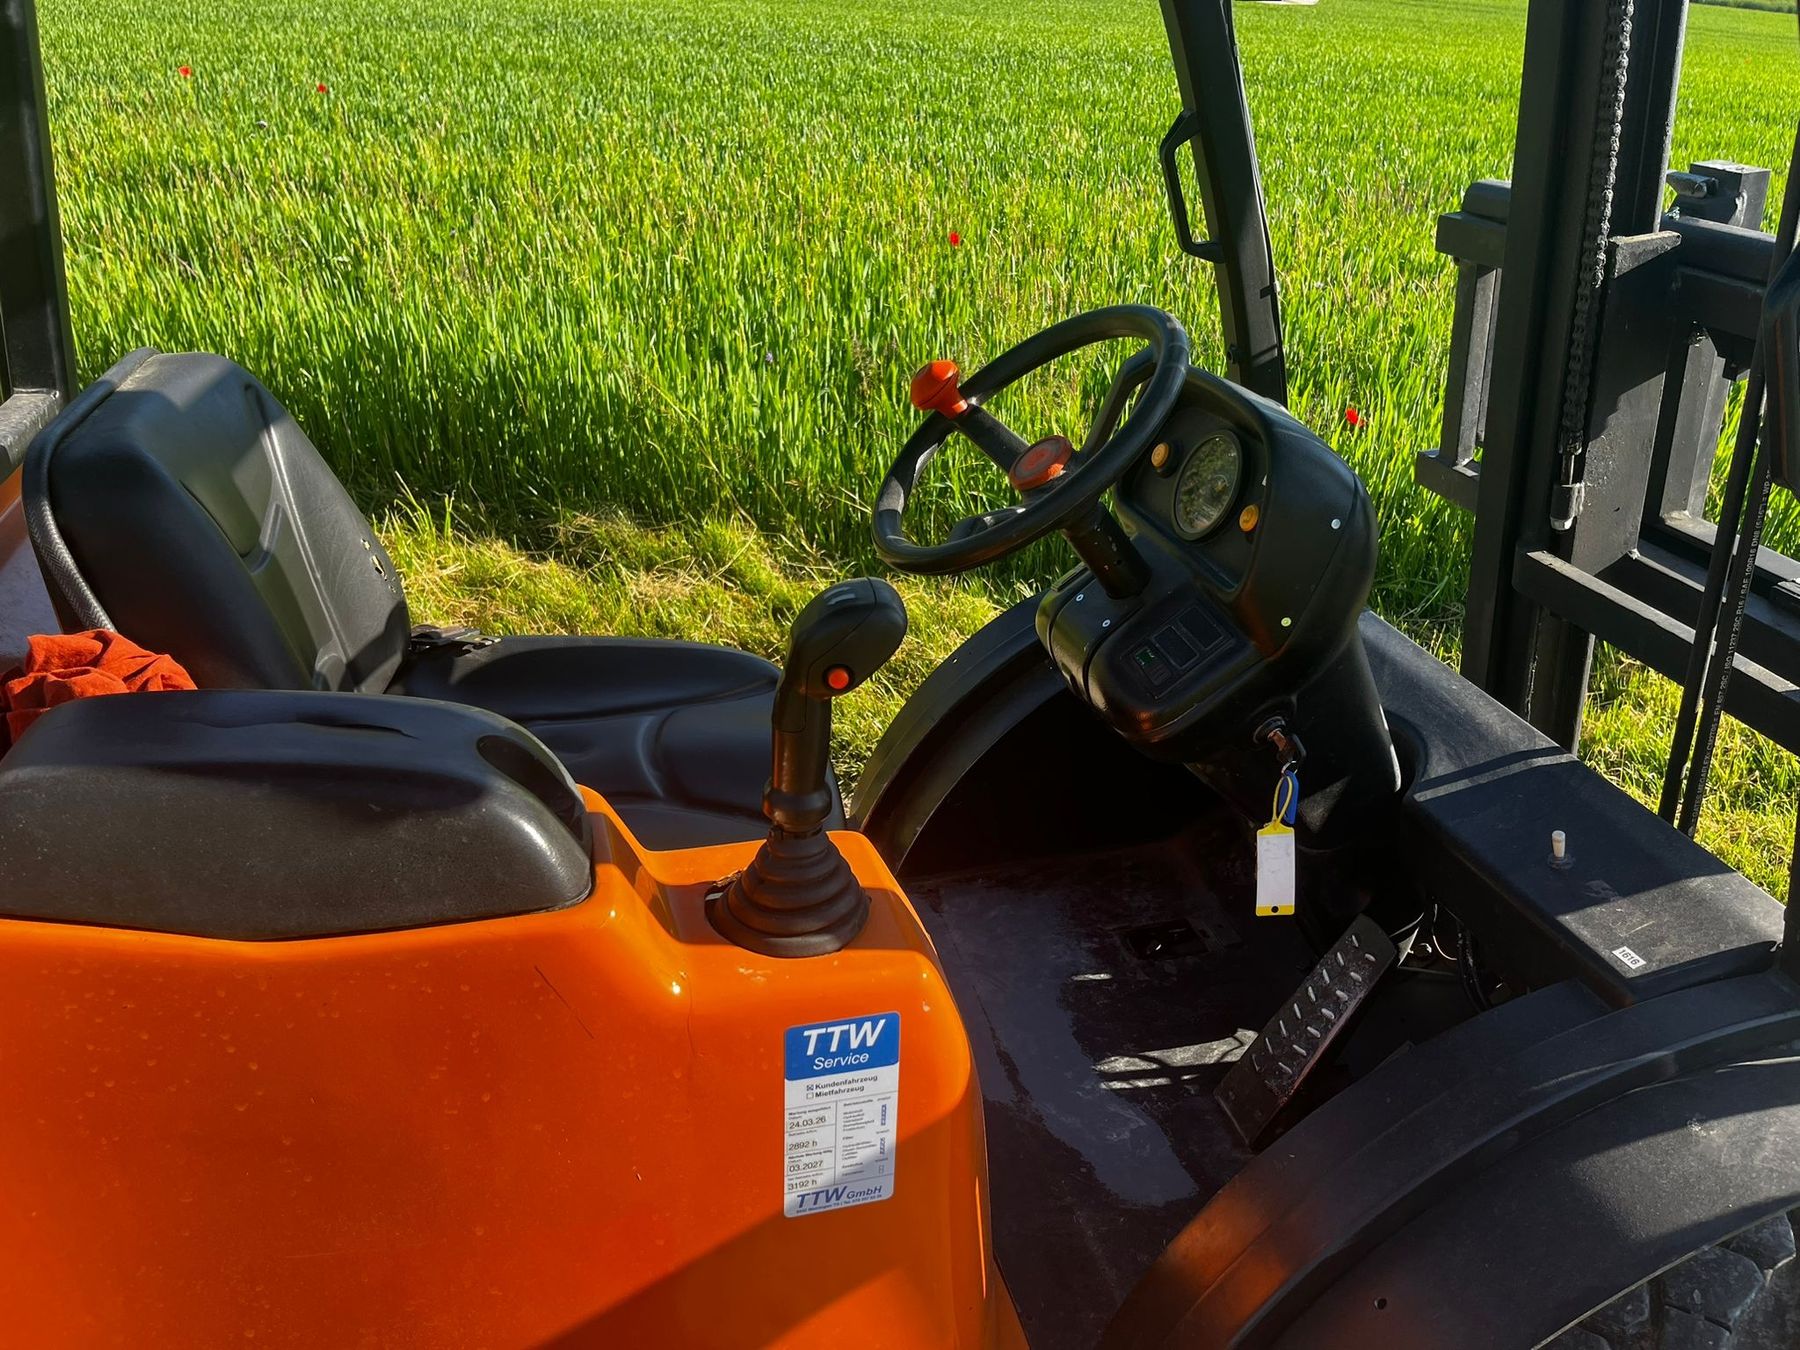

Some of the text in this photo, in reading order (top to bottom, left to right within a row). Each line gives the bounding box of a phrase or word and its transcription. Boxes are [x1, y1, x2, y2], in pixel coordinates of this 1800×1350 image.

[1745, 547, 1757, 576] 100R16
[1619, 949, 1640, 965] 1616
[803, 1019, 886, 1056] TTW
[813, 1053, 869, 1070] Service
[815, 1075, 878, 1090] Kundenfahrzeug
[815, 1085, 865, 1098] Mietfahrzeug
[797, 1185, 848, 1209] TTW
[846, 1185, 882, 1199] GmbH
